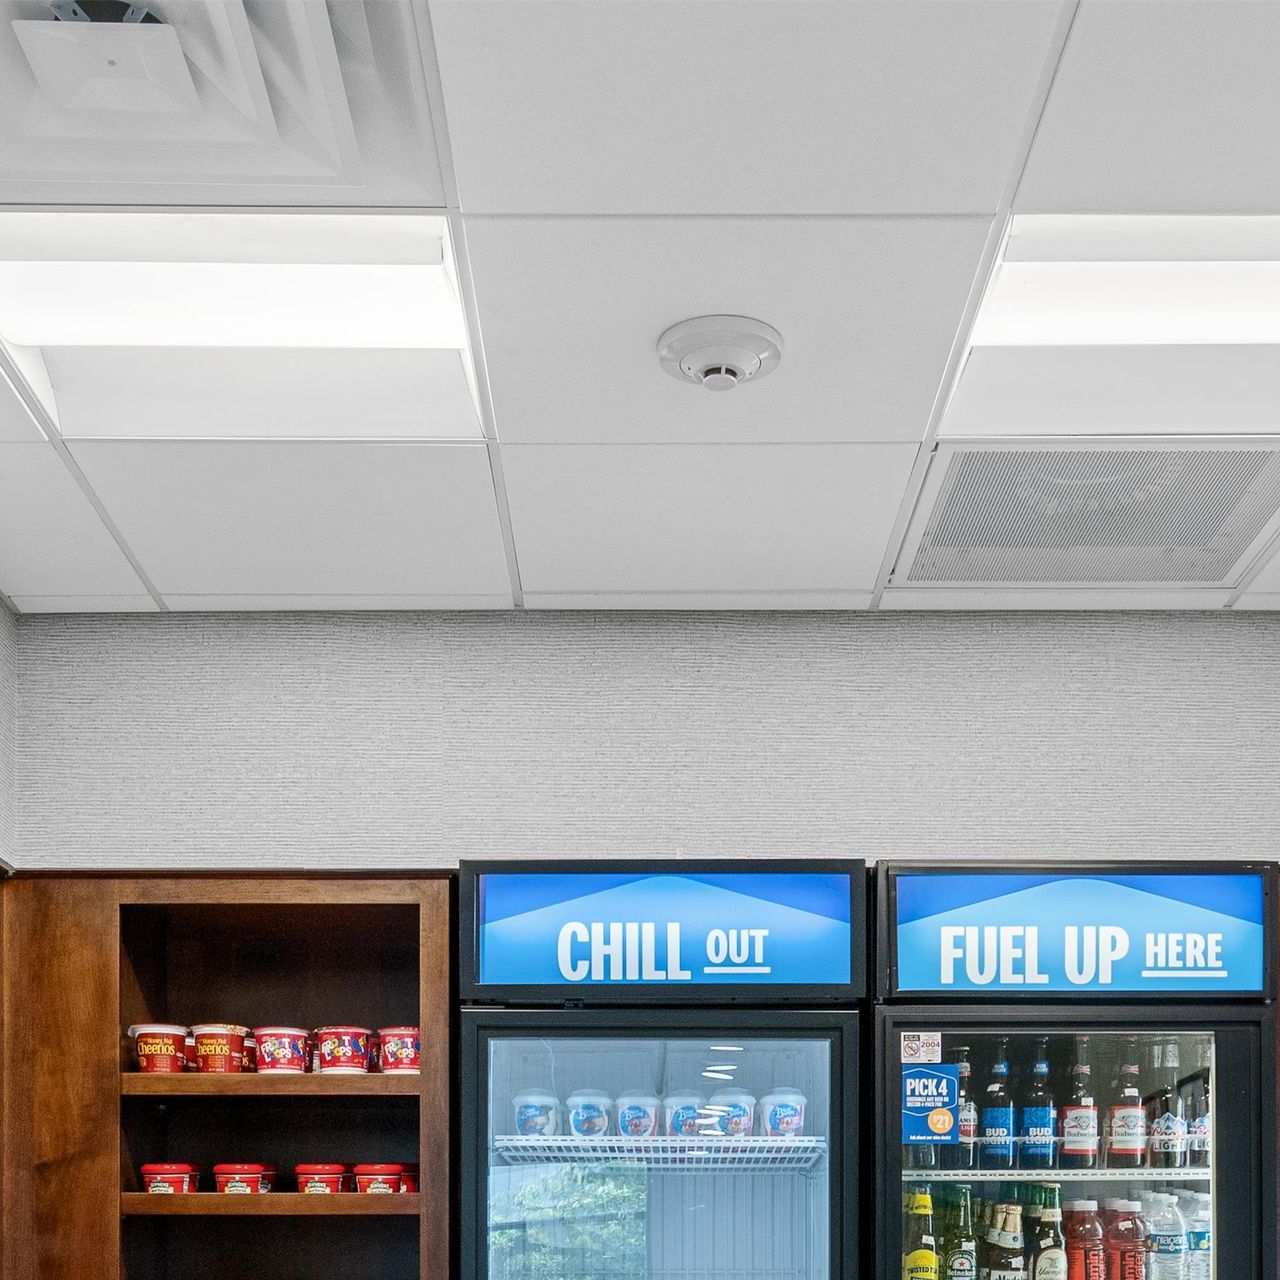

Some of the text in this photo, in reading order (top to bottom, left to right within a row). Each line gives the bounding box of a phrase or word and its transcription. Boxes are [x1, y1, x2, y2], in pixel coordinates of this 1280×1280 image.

[557, 921, 770, 981] CHILL OUT
[940, 926, 1223, 985] FUEL UP HERE
[137, 1042, 175, 1055] Cheerios
[906, 1078, 948, 1096] PICK 4
[985, 1127, 1008, 1136] BUD
[1029, 1127, 1052, 1136] BUD
